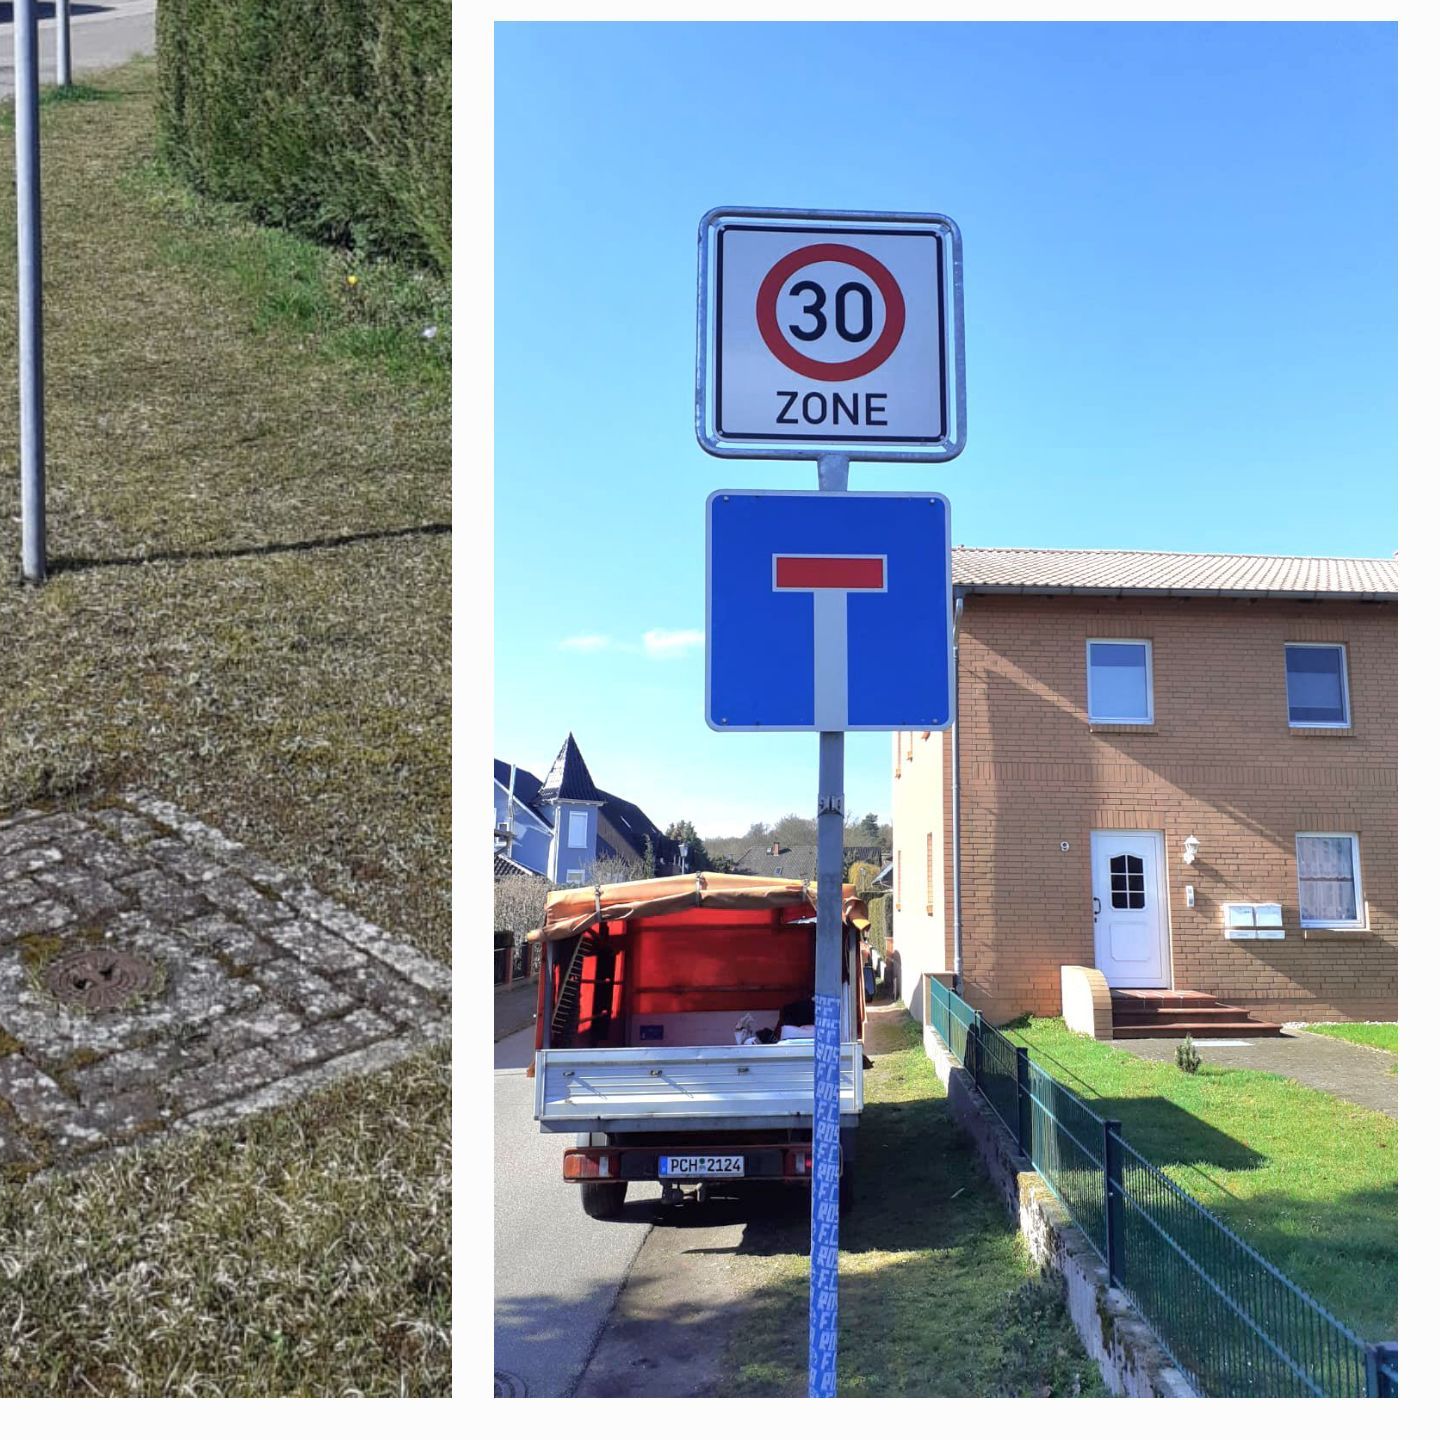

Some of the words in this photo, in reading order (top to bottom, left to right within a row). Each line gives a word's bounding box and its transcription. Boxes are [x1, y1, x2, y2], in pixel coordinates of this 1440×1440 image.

[788, 280, 873, 343] 30
[776, 391, 888, 426] ZONE
[671, 1158, 698, 1172] PCH
[707, 1159, 740, 1172] 2124
